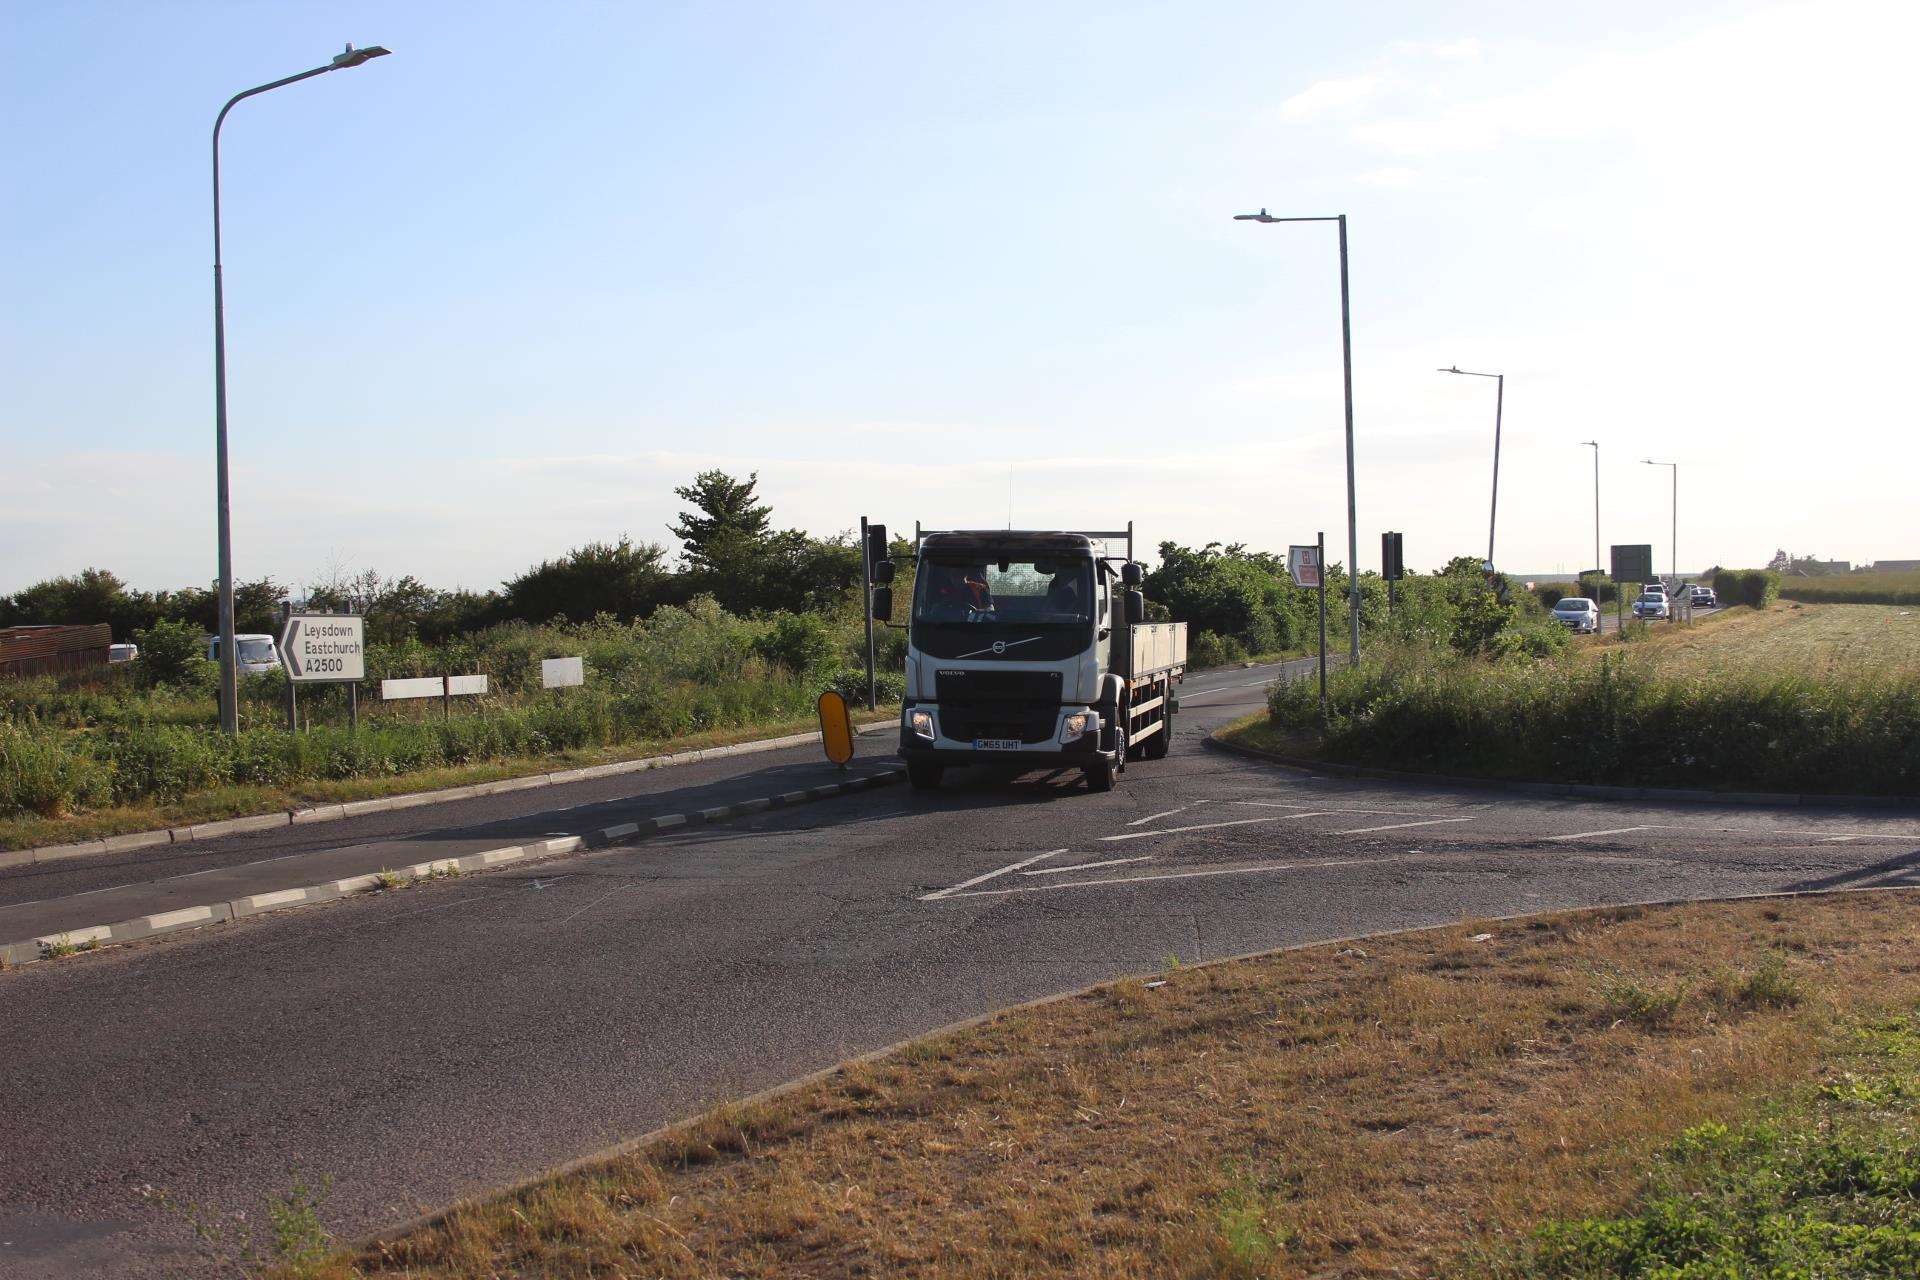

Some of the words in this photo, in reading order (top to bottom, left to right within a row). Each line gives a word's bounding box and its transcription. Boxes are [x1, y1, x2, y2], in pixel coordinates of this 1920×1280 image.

[304, 623, 353, 639] Leysdown
[305, 641, 361, 655] Eastchurch
[305, 658, 343, 673] A2500
